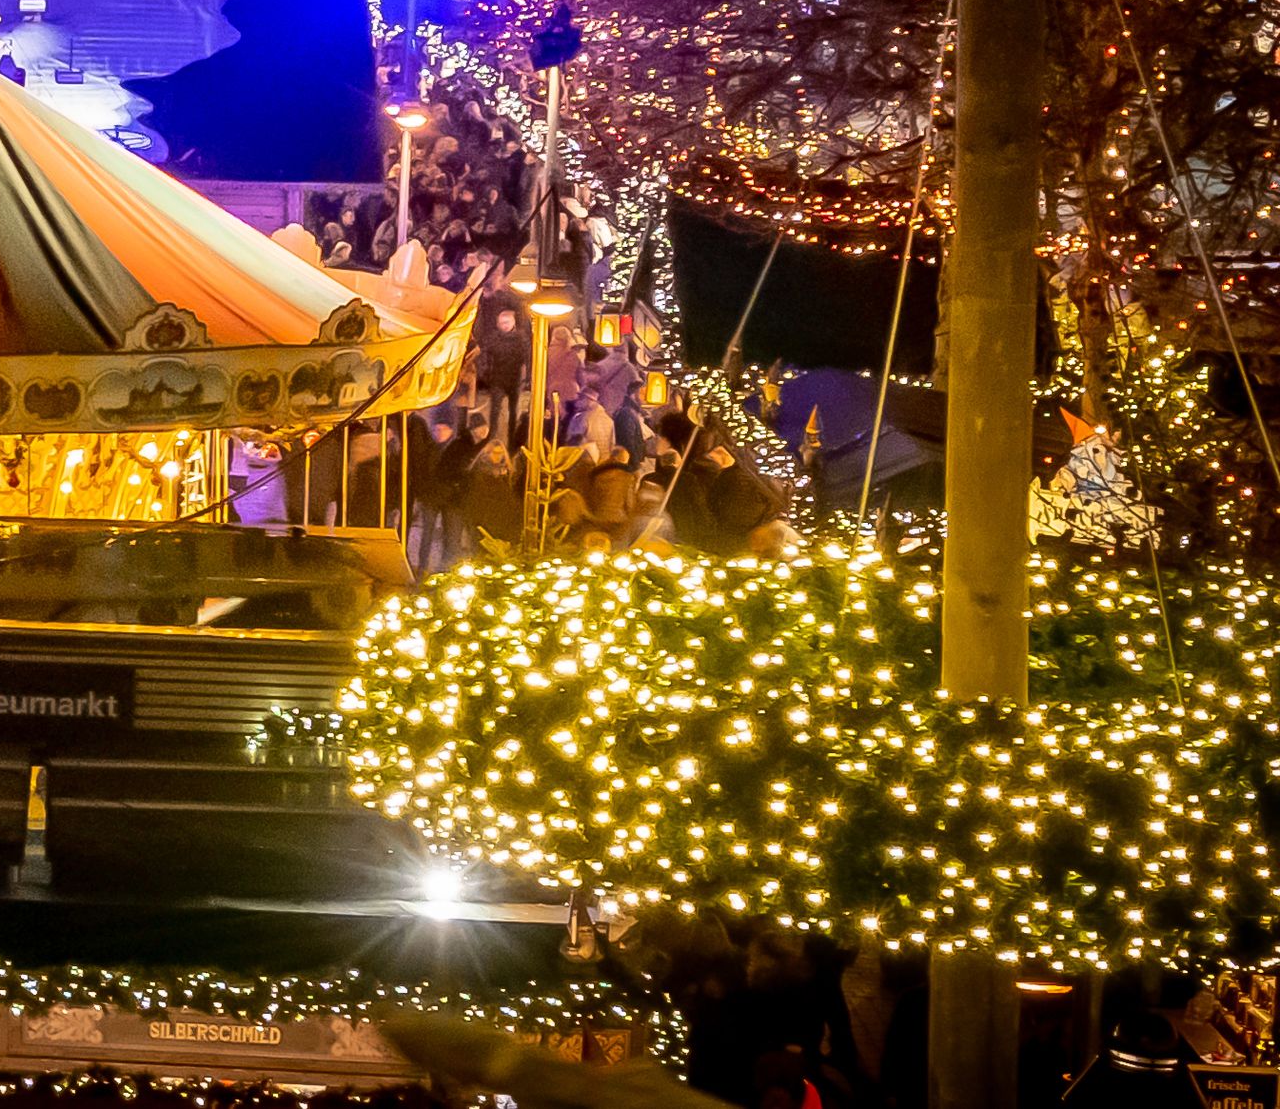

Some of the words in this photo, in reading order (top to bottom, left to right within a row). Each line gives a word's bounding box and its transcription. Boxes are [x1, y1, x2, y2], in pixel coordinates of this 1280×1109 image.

[148, 1021, 282, 1045] SILBERSCHMIED
[1207, 1078, 1251, 1091] frische
[1210, 1097, 1264, 1109] affeln
